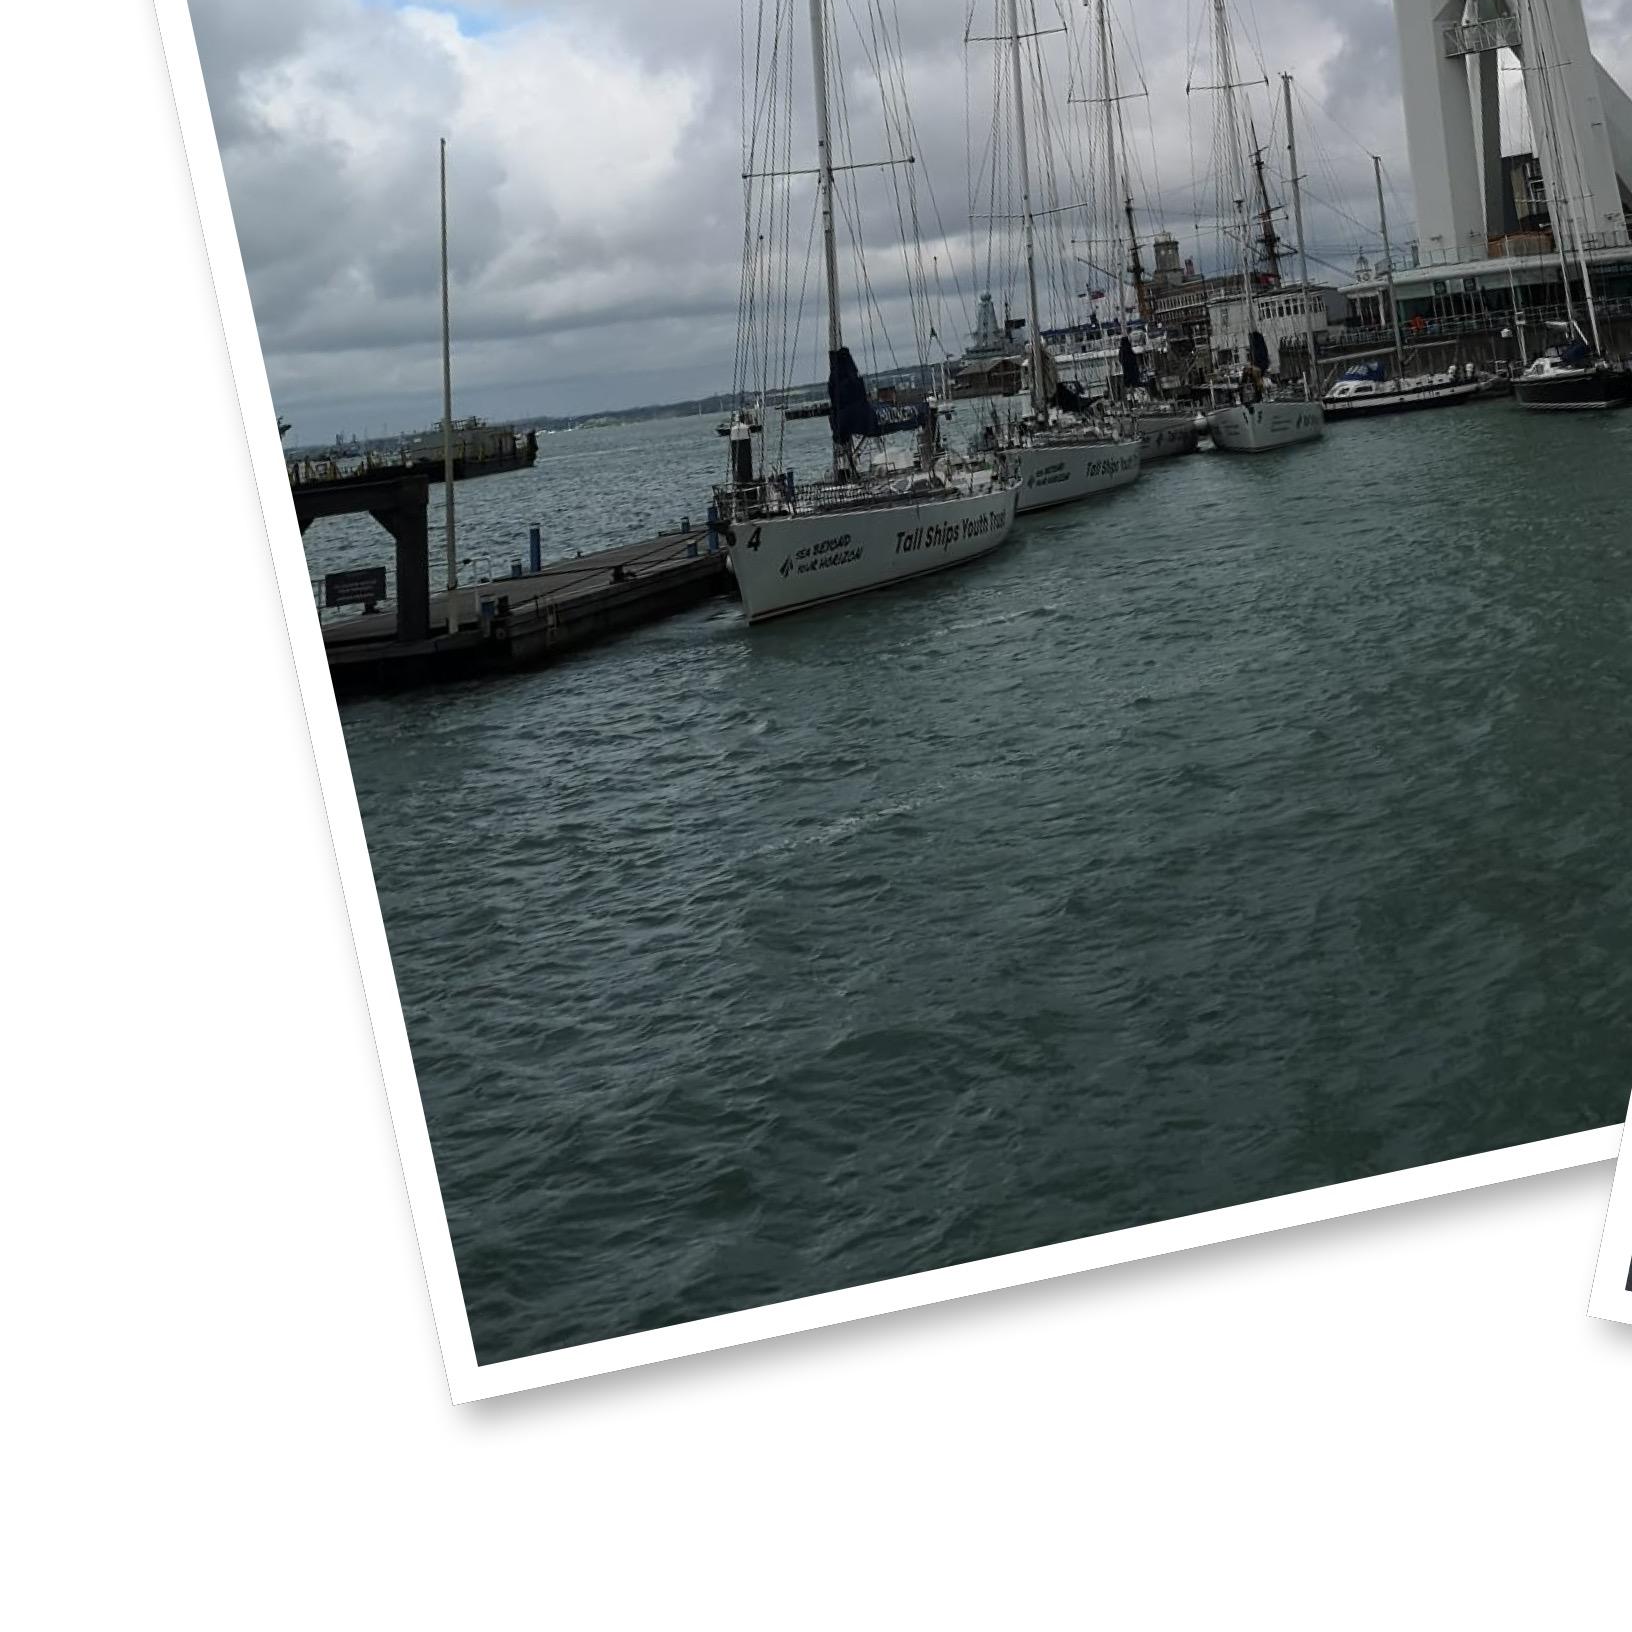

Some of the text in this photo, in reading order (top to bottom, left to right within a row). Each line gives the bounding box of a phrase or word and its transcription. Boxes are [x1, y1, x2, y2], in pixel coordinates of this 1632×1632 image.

[747, 526, 762, 552] 4
[895, 528, 923, 554] Tall
[925, 521, 959, 552] Ships
[961, 513, 988, 539] Youth
